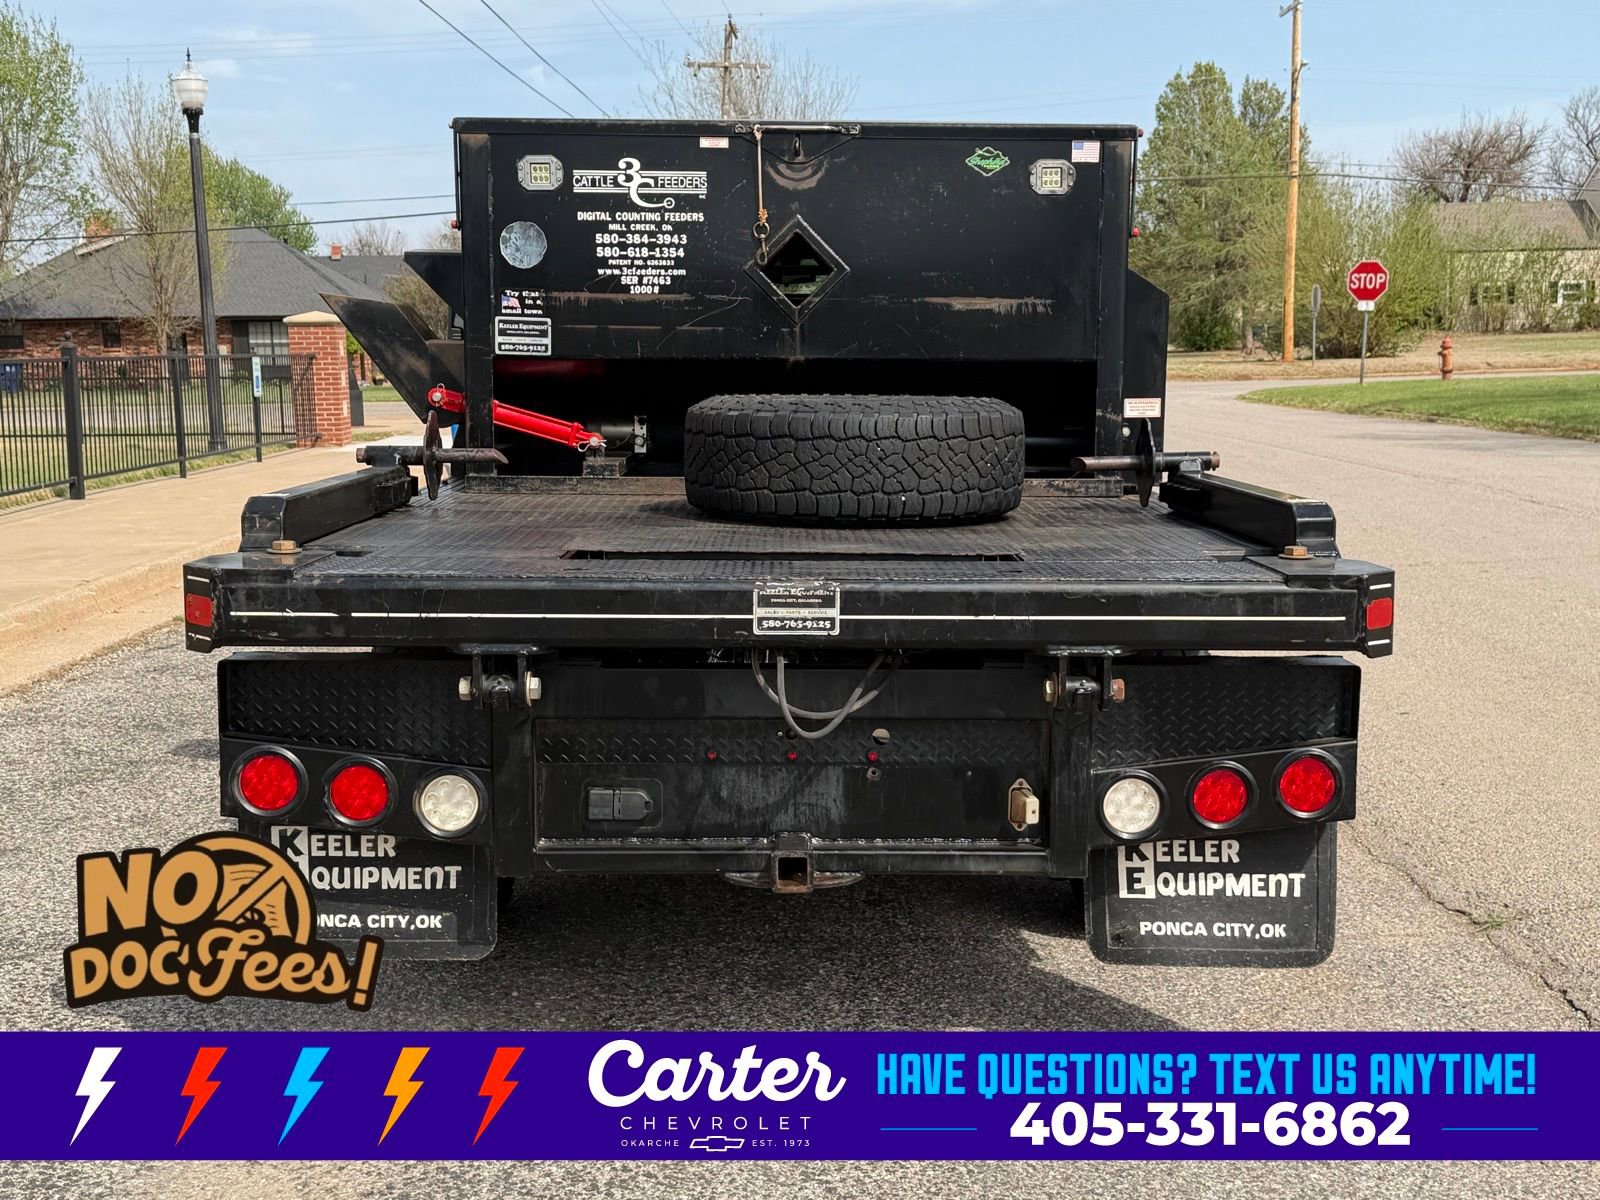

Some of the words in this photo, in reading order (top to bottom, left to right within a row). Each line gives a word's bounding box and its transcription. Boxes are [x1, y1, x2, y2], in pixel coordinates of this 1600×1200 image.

[572, 175, 614, 187] CATTLE
[657, 176, 708, 189] FEEDERS
[577, 211, 612, 221] DIGITAL
[615, 212, 661, 222] COUNTING
[664, 212, 705, 222] FEEDERS
[608, 223, 627, 231] MILL
[595, 233, 688, 244] 580-384-3943
[596, 246, 685, 258] 580-618-1354
[597, 267, 687, 276] www.3cfeeders.com
[620, 276, 639, 285] SER
[642, 276, 671, 285] #7463
[1350, 272, 1386, 289] STOP
[762, 619, 832, 629] 580-765-9125
[310, 864, 463, 891] QUIPMENT
[1140, 921, 1208, 937] PONCA
